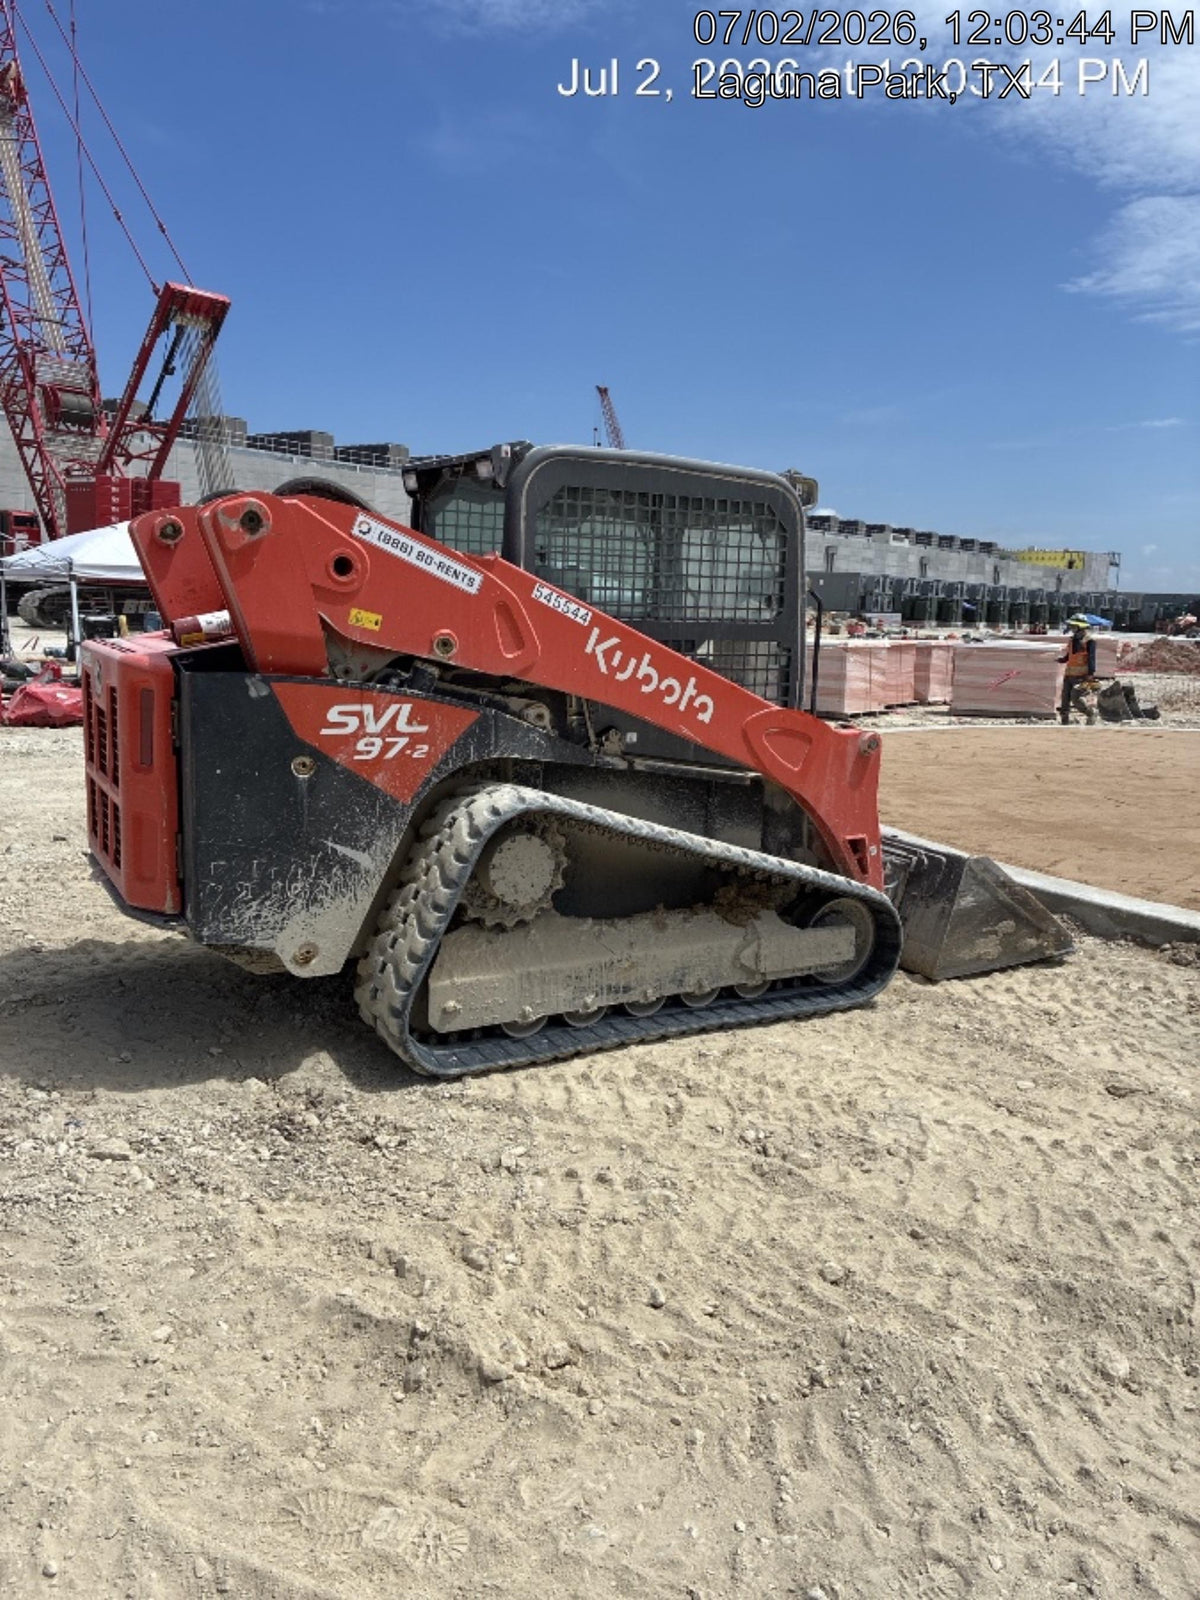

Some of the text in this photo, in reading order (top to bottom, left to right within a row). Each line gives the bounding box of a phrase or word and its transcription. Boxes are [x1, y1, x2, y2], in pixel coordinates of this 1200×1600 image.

[377, 530, 476, 588] (888) 80-RENTS
[533, 585, 591, 625] 545544
[584, 626, 715, 725] Kubota
[319, 703, 429, 735] SVL
